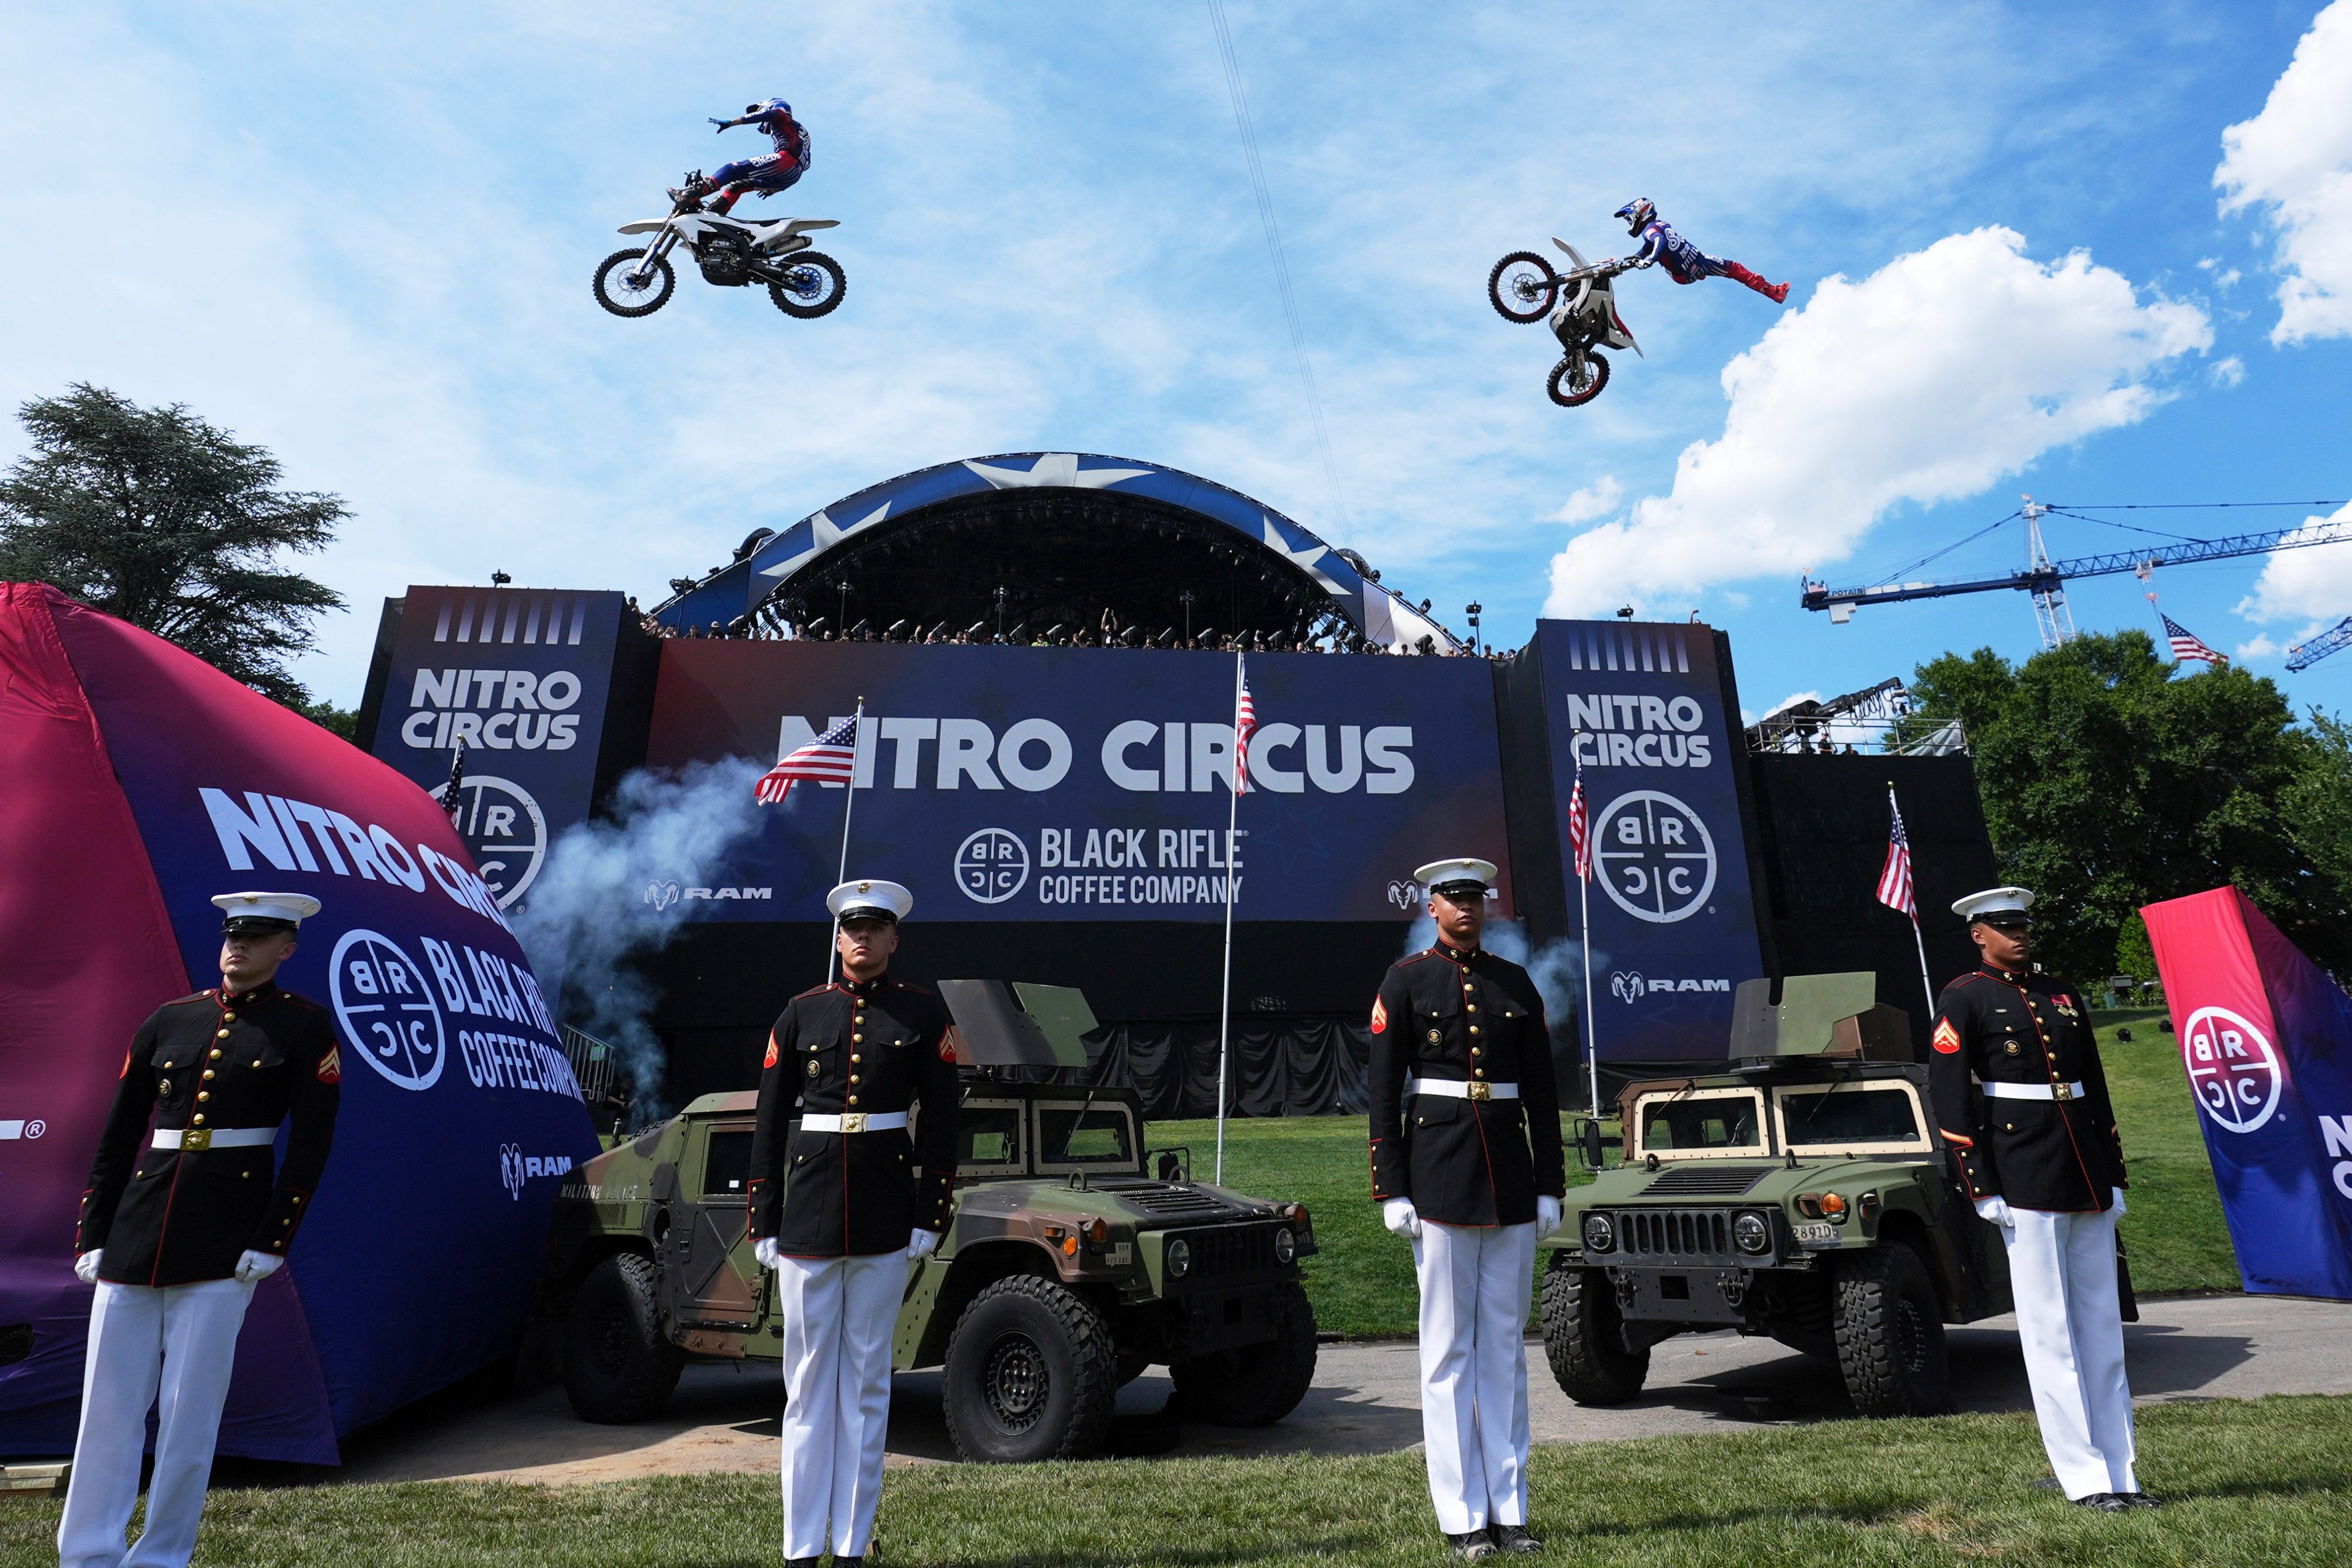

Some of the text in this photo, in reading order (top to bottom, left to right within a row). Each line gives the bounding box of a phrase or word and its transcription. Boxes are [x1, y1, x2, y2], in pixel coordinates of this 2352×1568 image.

[1832, 588, 1863, 597] POTAIN
[410, 668, 582, 711] NITRO
[401, 712, 580, 750] CIRCUS
[1567, 694, 1704, 733] NITRO
[1101, 720, 1415, 794] CIRCUS
[1570, 733, 1712, 768] CIRCUS
[198, 787, 426, 893] NITRO
[1040, 828, 1243, 869] BLACK RIFLE
[683, 887, 772, 899] RAM
[1040, 875, 1243, 904] COFFEE COMPANY
[420, 936, 532, 1026] BLACK
[1648, 979, 1731, 992] RAM
[459, 1030, 540, 1091] COFFEE
[525, 1156, 572, 1178] RAM
[560, 1183, 602, 1200] MILITARY
